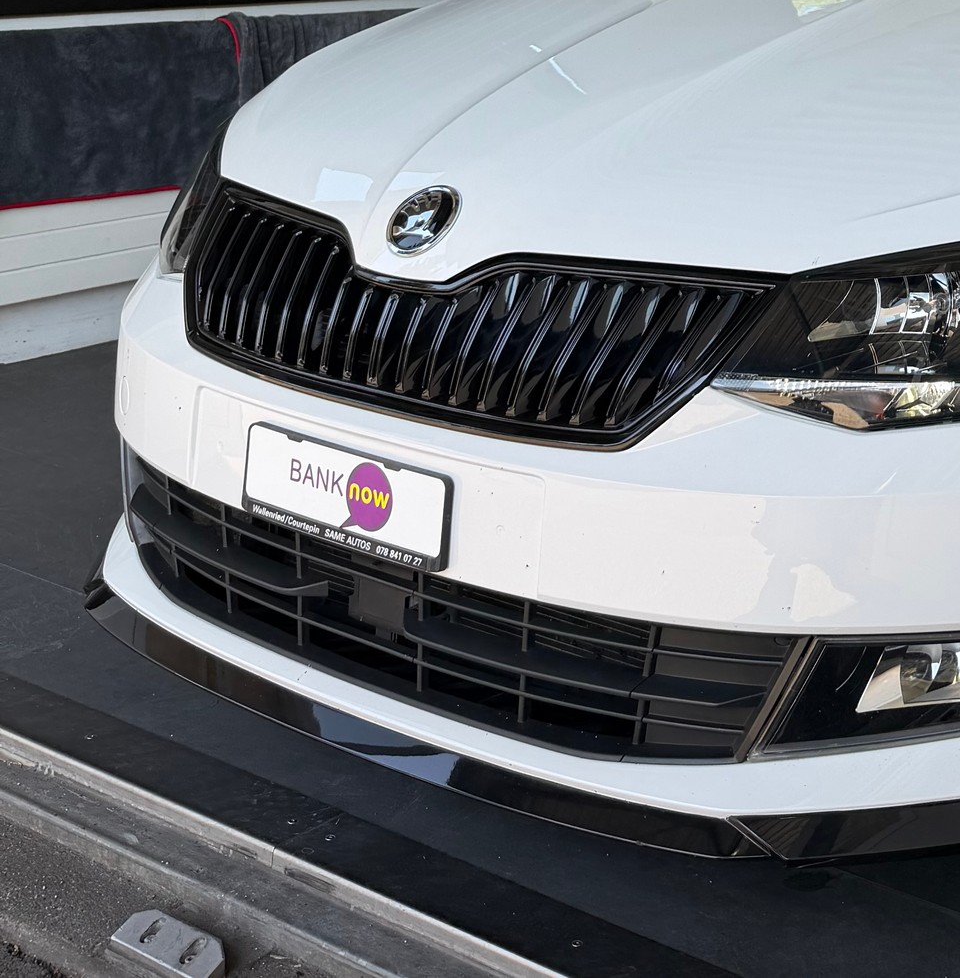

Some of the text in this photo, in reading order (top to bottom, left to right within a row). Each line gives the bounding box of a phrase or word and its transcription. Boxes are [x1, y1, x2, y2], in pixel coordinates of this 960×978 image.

[290, 458, 390, 510] BANK now
[252, 503, 423, 567] Wallenried/Courtepin SAME AUTOS 078 841 07 27
